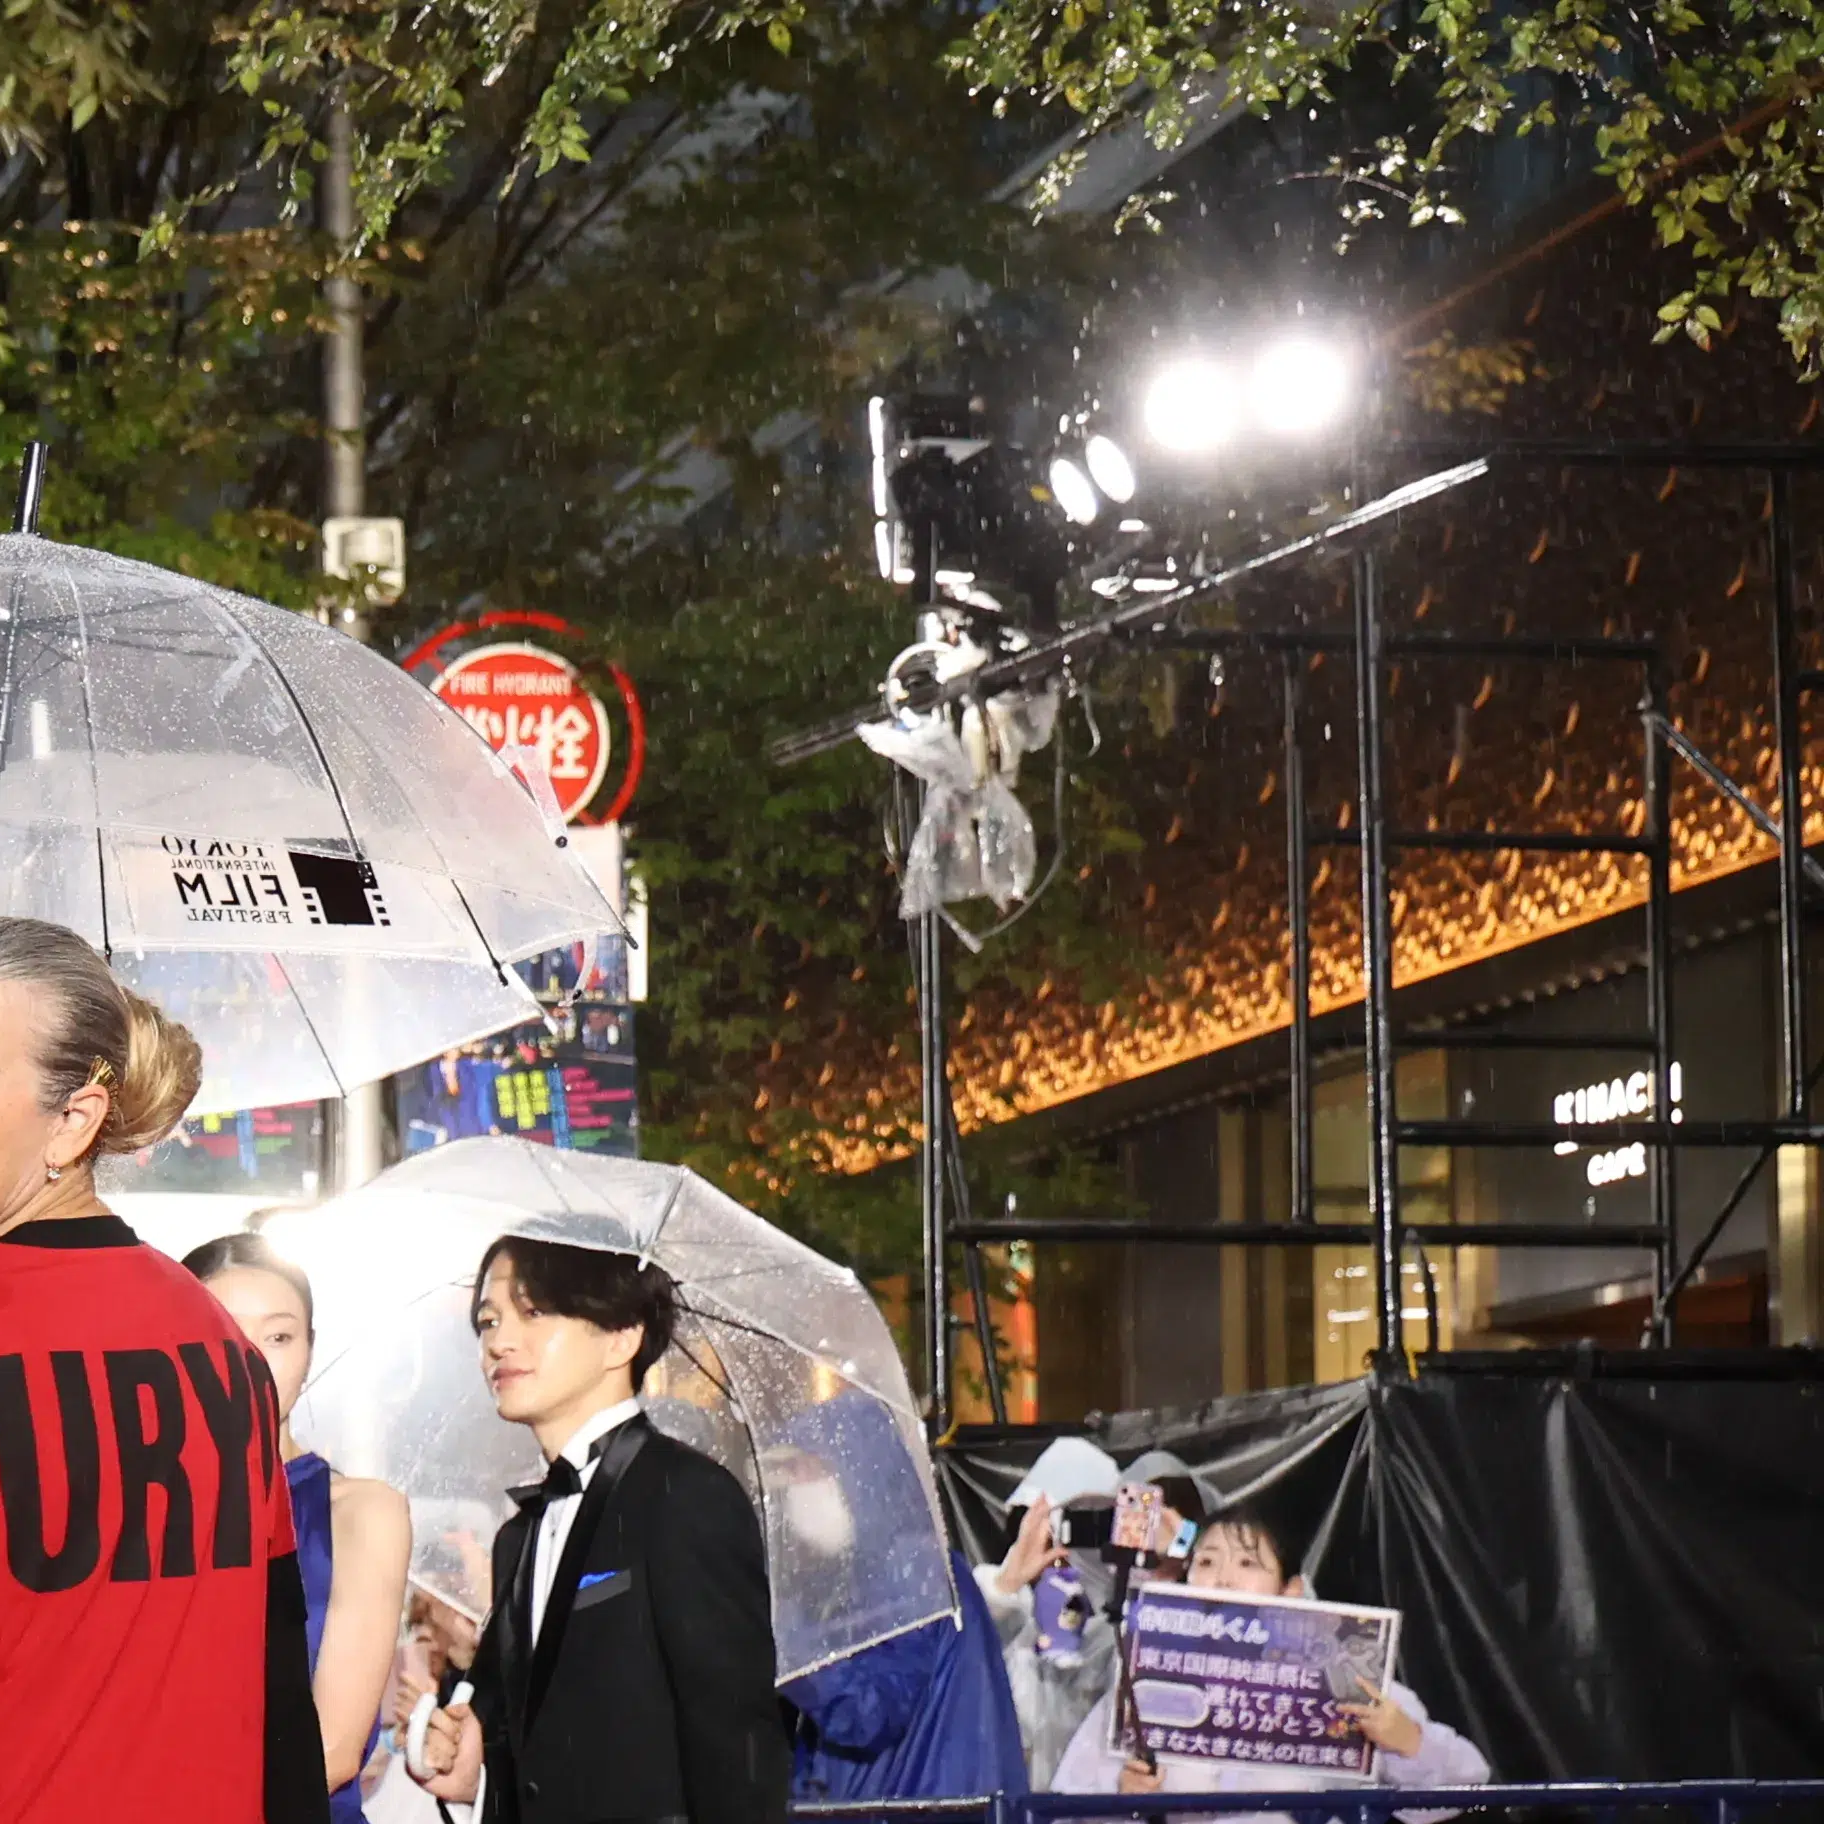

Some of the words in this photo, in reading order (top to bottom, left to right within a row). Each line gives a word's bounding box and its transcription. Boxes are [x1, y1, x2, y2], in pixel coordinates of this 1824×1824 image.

[451, 671, 489, 696] FIRE
[493, 672, 573, 697] HYDRANT
[1138, 1648, 1322, 1689] 東京国際映画祭に
[1205, 1682, 1340, 1715] 連れてきてく
[1212, 1707, 1327, 1737] ありがとう
